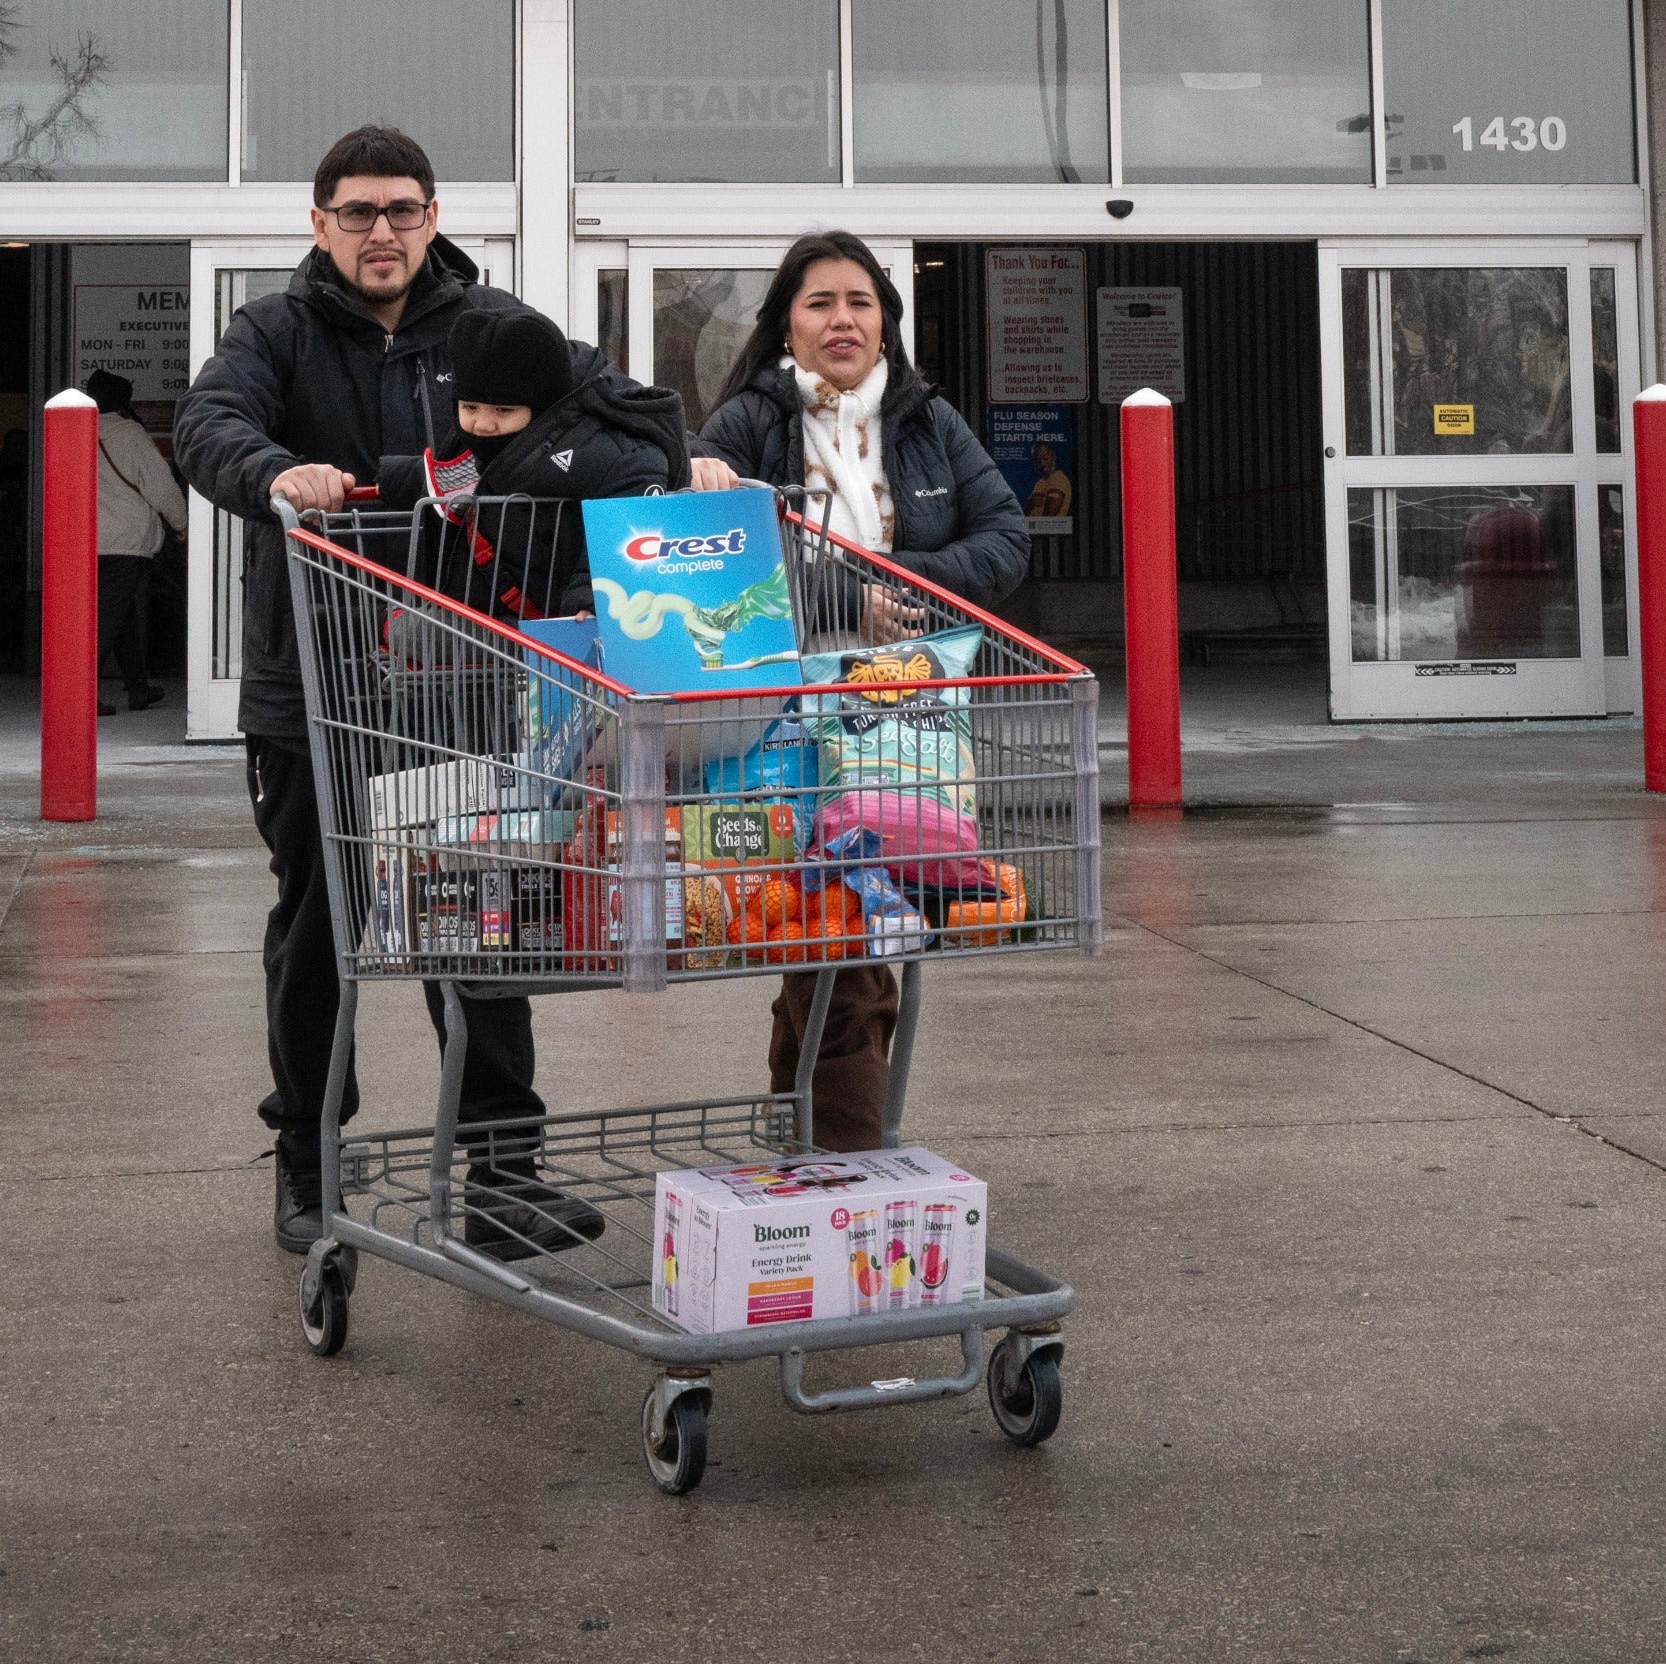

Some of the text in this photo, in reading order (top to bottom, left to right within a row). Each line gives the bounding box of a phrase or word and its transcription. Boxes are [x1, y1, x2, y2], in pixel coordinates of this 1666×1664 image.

[1452, 116, 1566, 151] 1430
[992, 256, 1025, 270] Thank
[1028, 256, 1047, 270] You
[1040, 316, 1065, 324] shoes
[119, 321, 190, 331] EXECUTIVE
[1003, 326, 1069, 334] and shirts while
[81, 339, 112, 350] MON
[125, 339, 145, 350] FRI
[1003, 336, 1041, 345] shopping
[1004, 346, 1017, 354] the
[80, 359, 152, 370] SATURDAY
[1005, 375, 1035, 384] inspect
[993, 411, 1059, 420] FLU SEASON
[993, 422, 1042, 431] DEFENSE
[993, 433, 1067, 442] STARTS HERE.
[626, 530, 745, 561] Crest
[657, 559, 724, 575] complete
[835, 1210, 846, 1220] 18
[887, 1218, 915, 1230] Bloom
[925, 1219, 952, 1232] Bloom
[753, 1224, 811, 1242] Bloom
[848, 1228, 877, 1241] Bloom
[759, 1244, 785, 1252] sparkling
[751, 1254, 811, 1269] Energy Drink
[760, 1265, 804, 1276] Variety Pack
